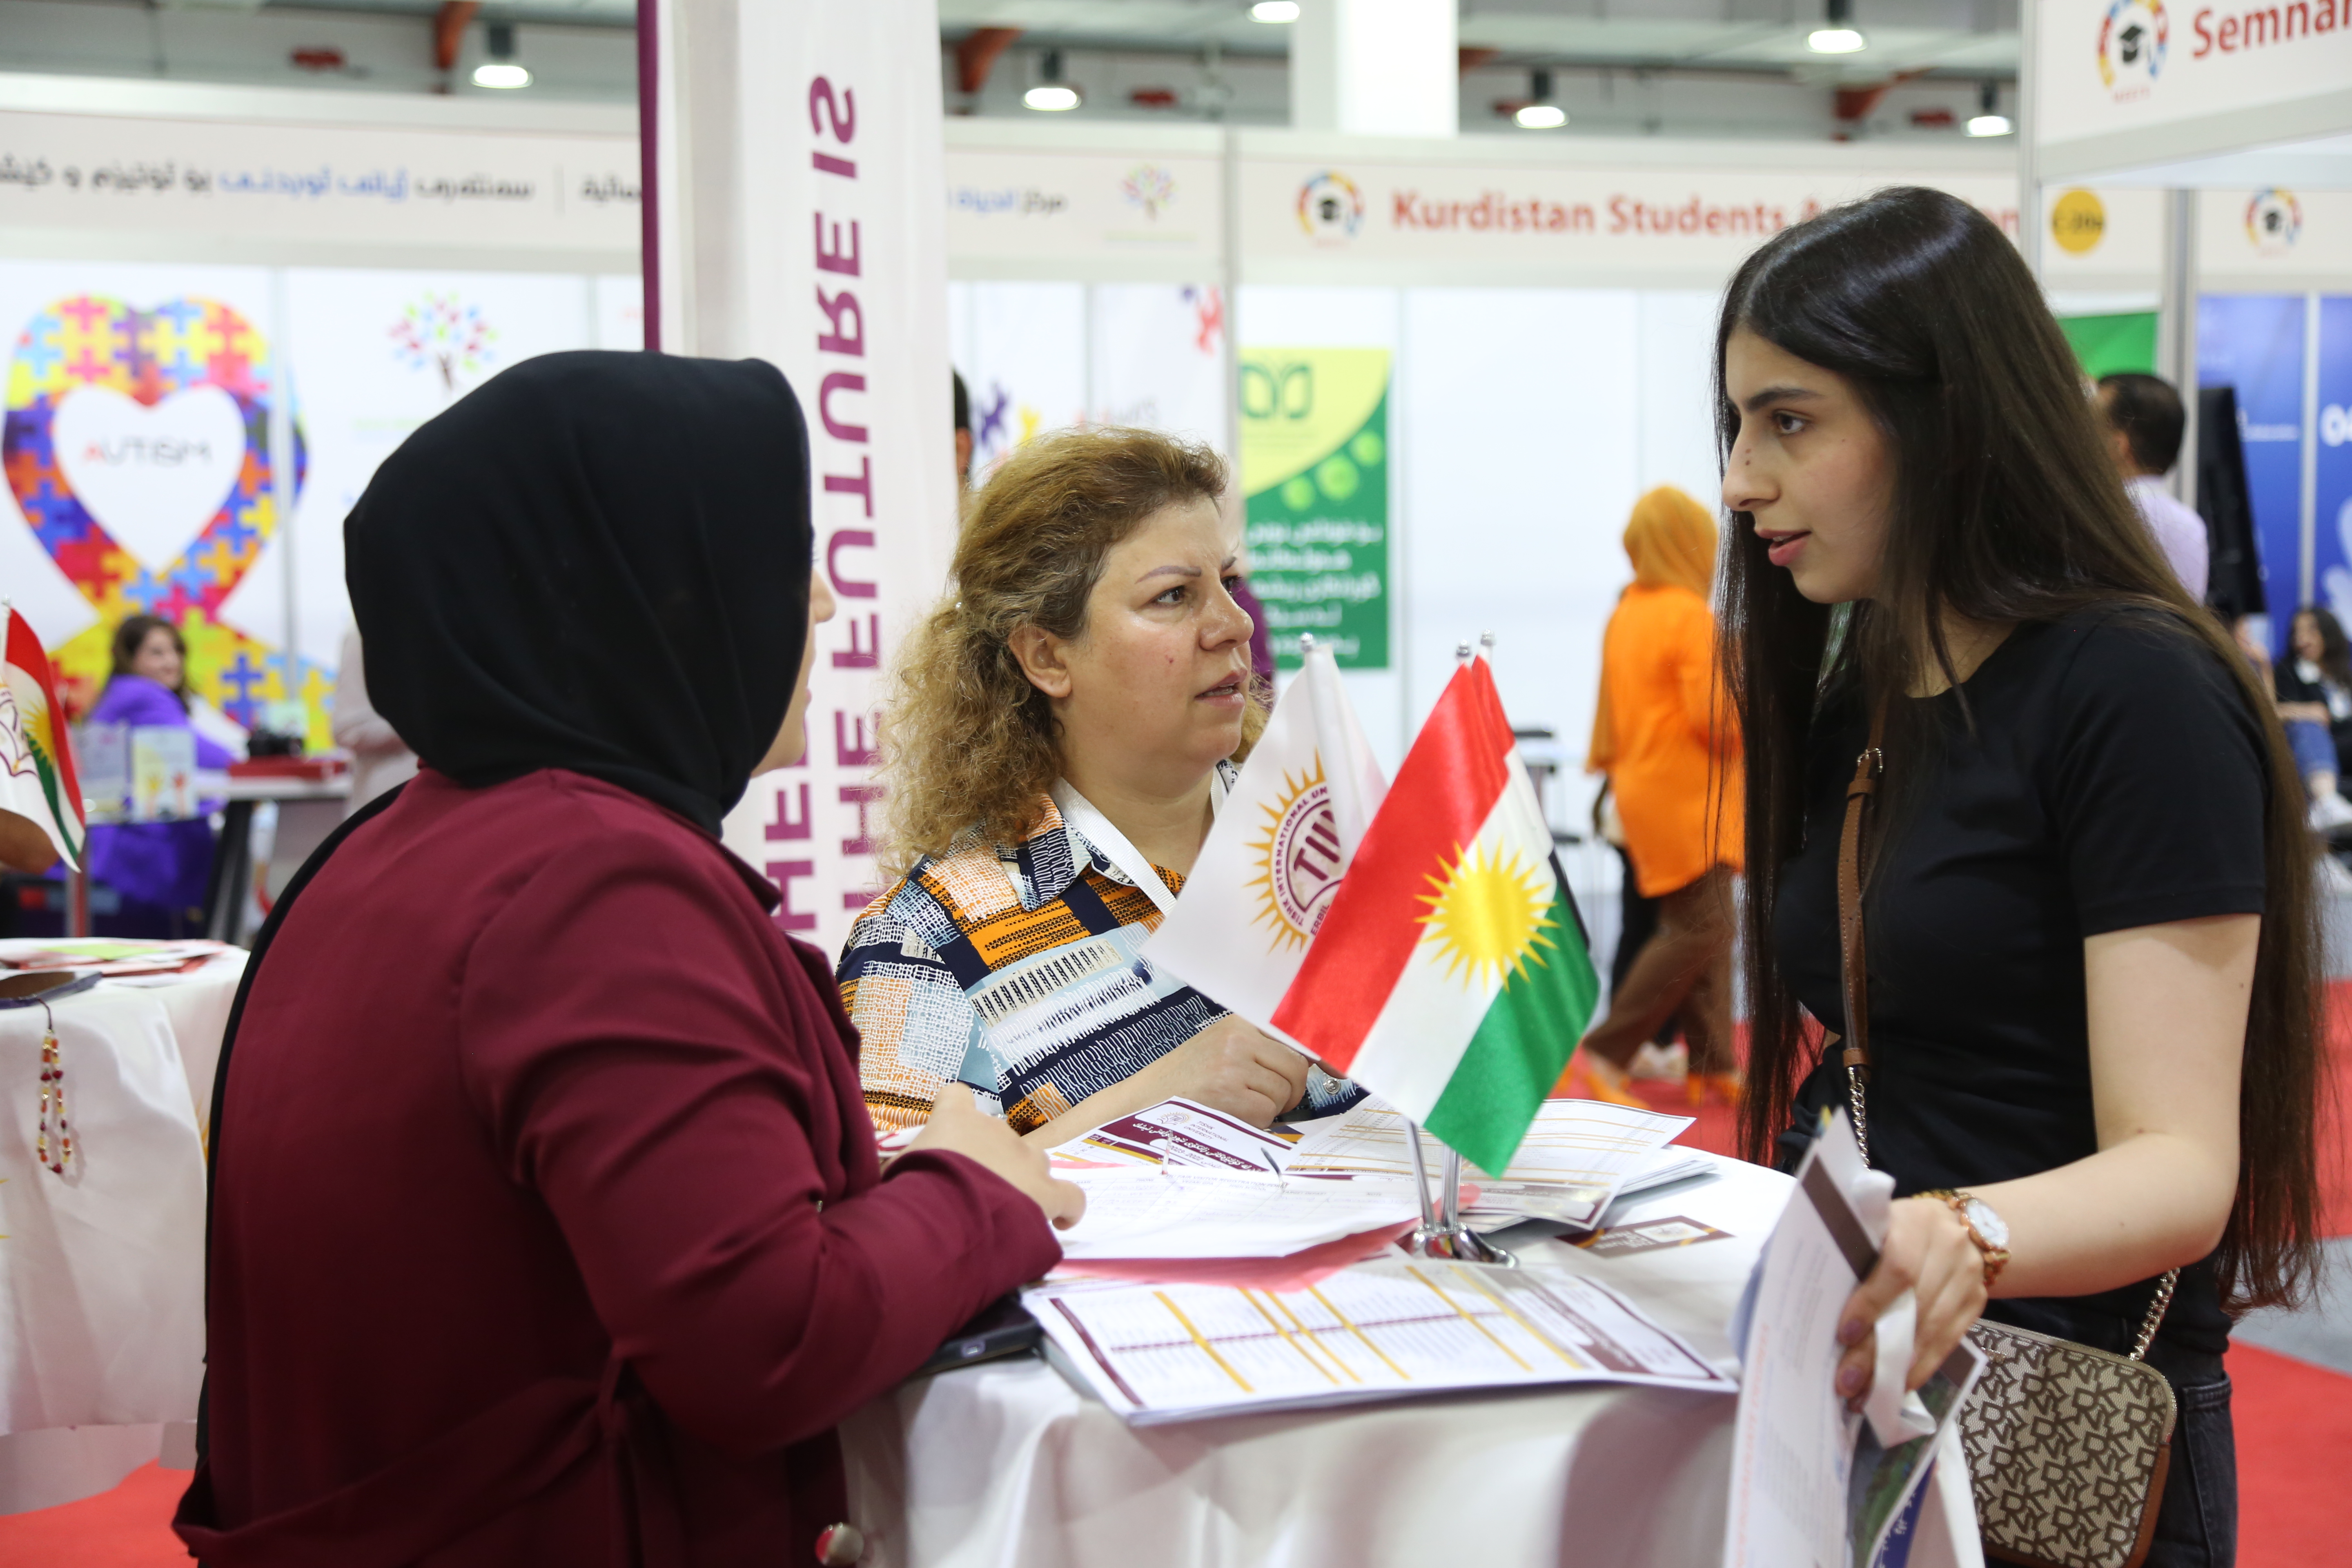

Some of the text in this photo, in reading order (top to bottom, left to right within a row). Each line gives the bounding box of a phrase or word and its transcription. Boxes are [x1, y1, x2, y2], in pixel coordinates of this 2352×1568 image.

[1392, 192, 1596, 233] Kurdistan
[1608, 194, 1786, 236] Students
[85, 434, 213, 466] AUTISM
[1276, 798, 1310, 897] INTERNATIONAL
[1283, 897, 1304, 926] TISHK
[1183, 1126, 1214, 1140] UNIVERSITY
[1189, 1124, 1229, 1142] INTERNATIONAL
[1197, 1120, 1216, 1130] TISHK
[1219, 1178, 1266, 1187] REGISTRATION
